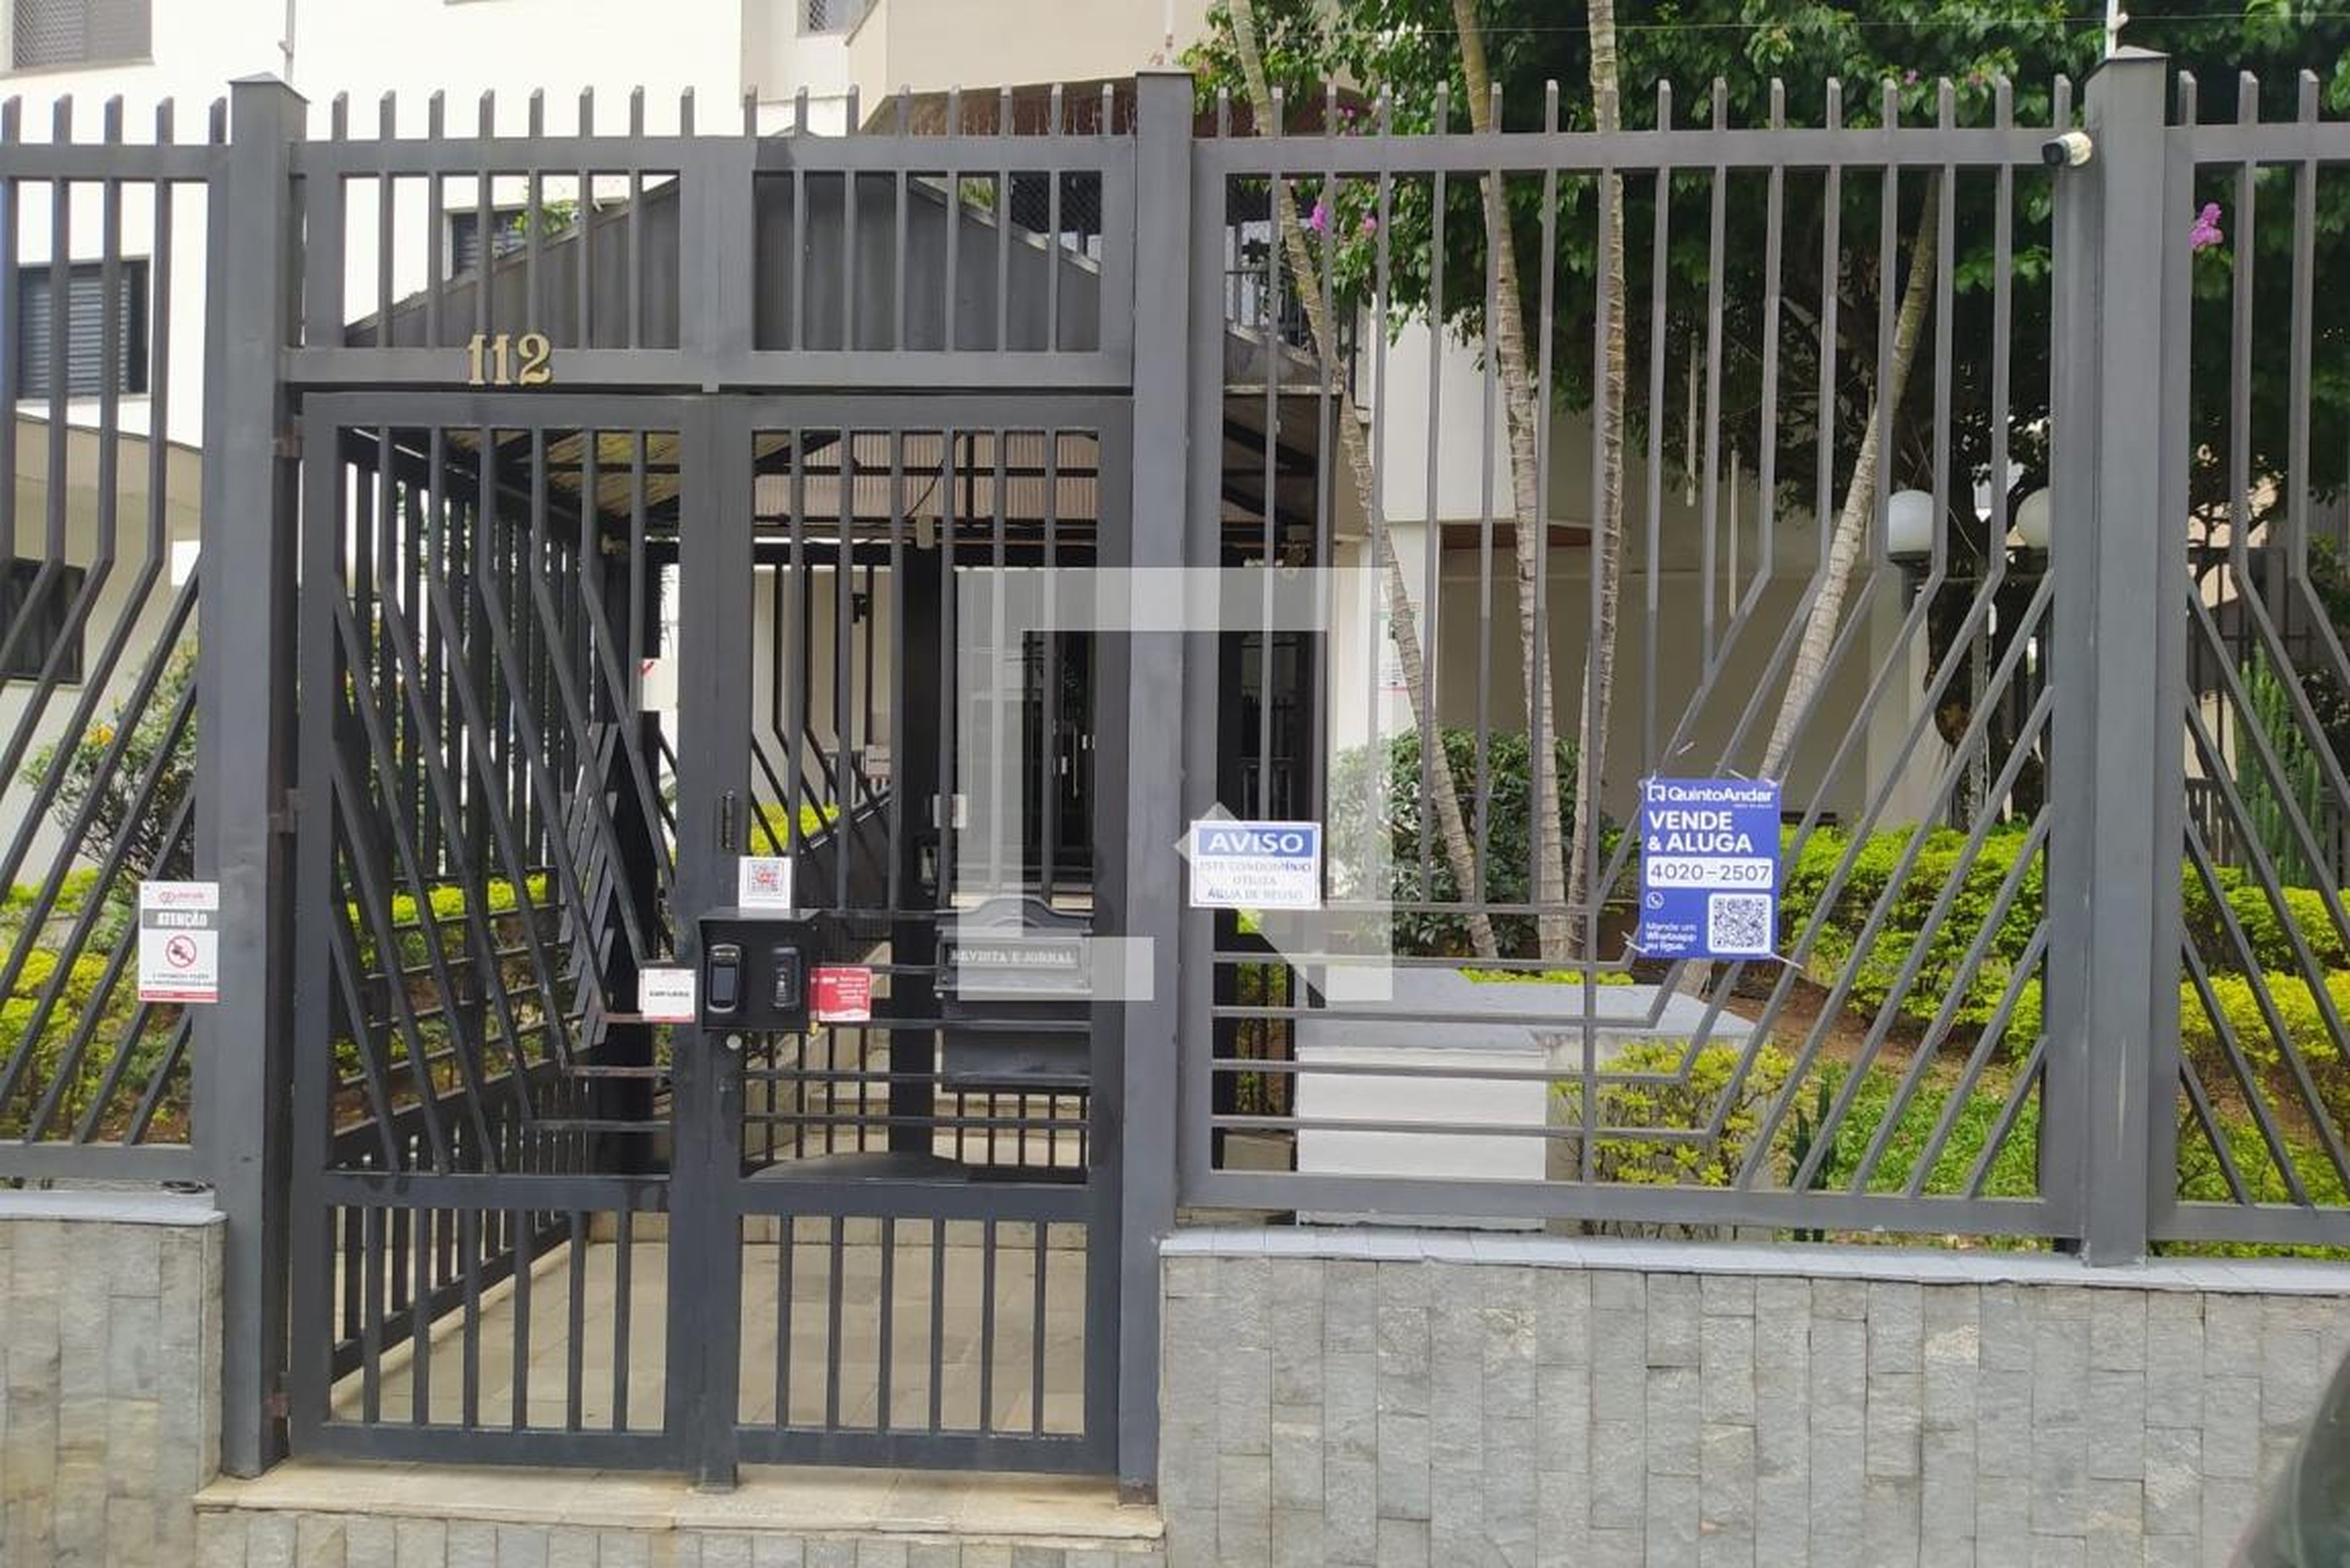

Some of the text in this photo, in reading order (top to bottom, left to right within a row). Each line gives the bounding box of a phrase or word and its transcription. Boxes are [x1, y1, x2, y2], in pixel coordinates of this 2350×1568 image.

[467, 334, 550, 385] 112
[1668, 786, 1773, 802] QuintoAndar
[1649, 811, 1733, 830] VENDE
[1208, 832, 1304, 853] AVISO
[1647, 833, 1753, 853] & ALUGA
[1651, 864, 1770, 881] 4020-2507
[157, 911, 207, 928] ATENÇÃO
